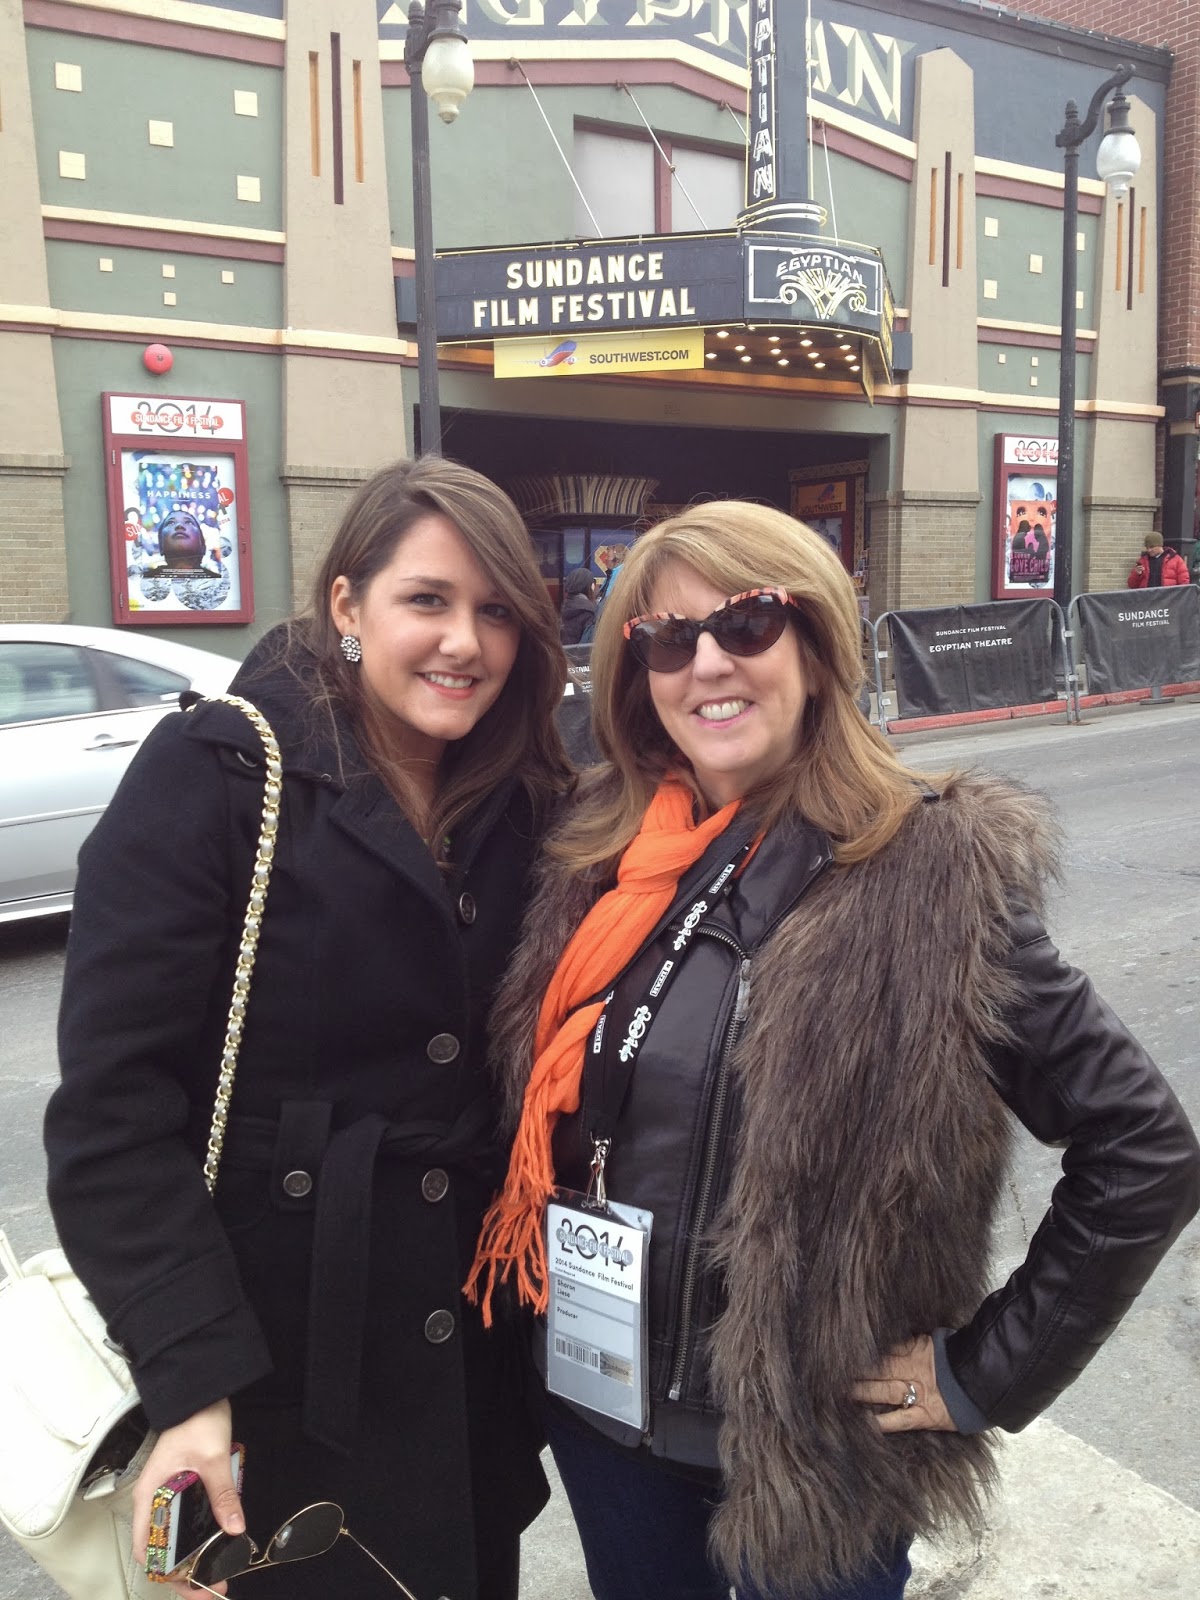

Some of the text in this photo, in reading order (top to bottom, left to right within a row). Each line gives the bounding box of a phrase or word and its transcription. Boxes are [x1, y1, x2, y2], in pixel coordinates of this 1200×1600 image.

[506, 252, 664, 289] SUNDANCE
[776, 255, 863, 285] EGYPTIAN
[473, 287, 696, 328] FILM FESTIVAL
[589, 350, 689, 364] SOUTHWEST.COM
[137, 401, 217, 435] 2014
[147, 490, 211, 499] HAPPINESS
[800, 502, 843, 513] SOUTHWEST
[1118, 608, 1170, 621] SUNDANCE
[935, 628, 967, 636] SUNDANCE
[929, 638, 1013, 653] EGYPTIAN THEATRE
[561, 1218, 628, 1271] 2014
[555, 1257, 568, 1267] 2014
[568, 1261, 596, 1278] Sundance
[598, 1272, 610, 1283] Film
[610, 1277, 634, 1291] Festival
[557, 1279, 576, 1292] Sharon
[557, 1306, 579, 1320] Producer
